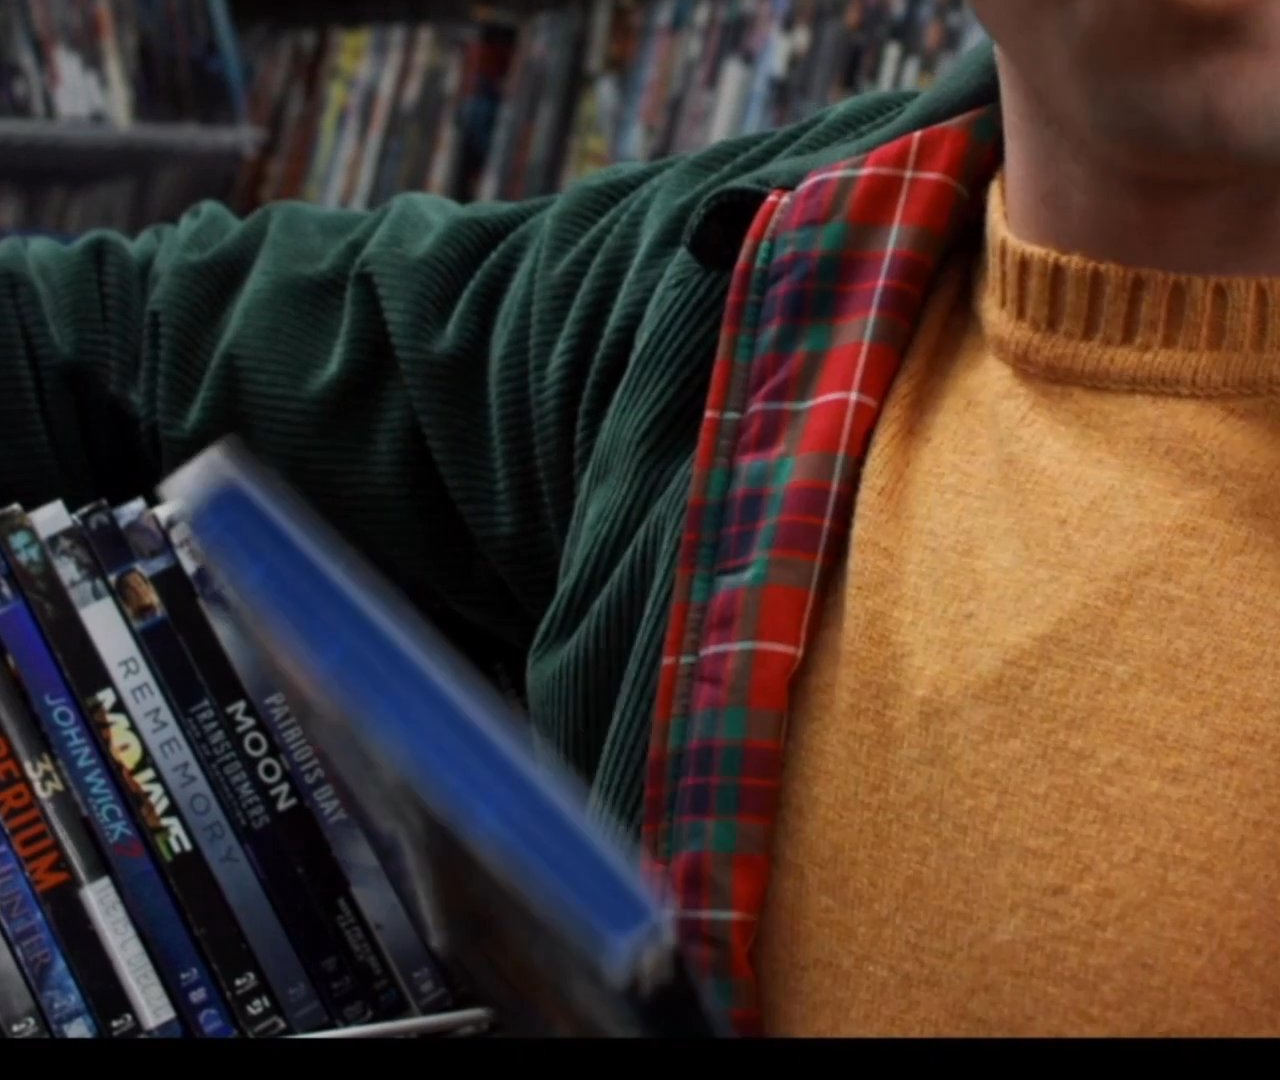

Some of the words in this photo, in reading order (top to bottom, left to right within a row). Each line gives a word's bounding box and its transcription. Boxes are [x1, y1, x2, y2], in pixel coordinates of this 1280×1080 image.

[22, 750, 62, 802] 33
[40, 687, 98, 770] JOHN
[80, 763, 137, 844] WICK
[84, 684, 194, 864] MOJAVE
[115, 653, 243, 874] REMEMORY
[187, 696, 272, 833] TRANSFORMERS
[223, 697, 299, 814] MOON
[263, 689, 329, 786] PATRIOTS
[311, 781, 350, 828] DAY
